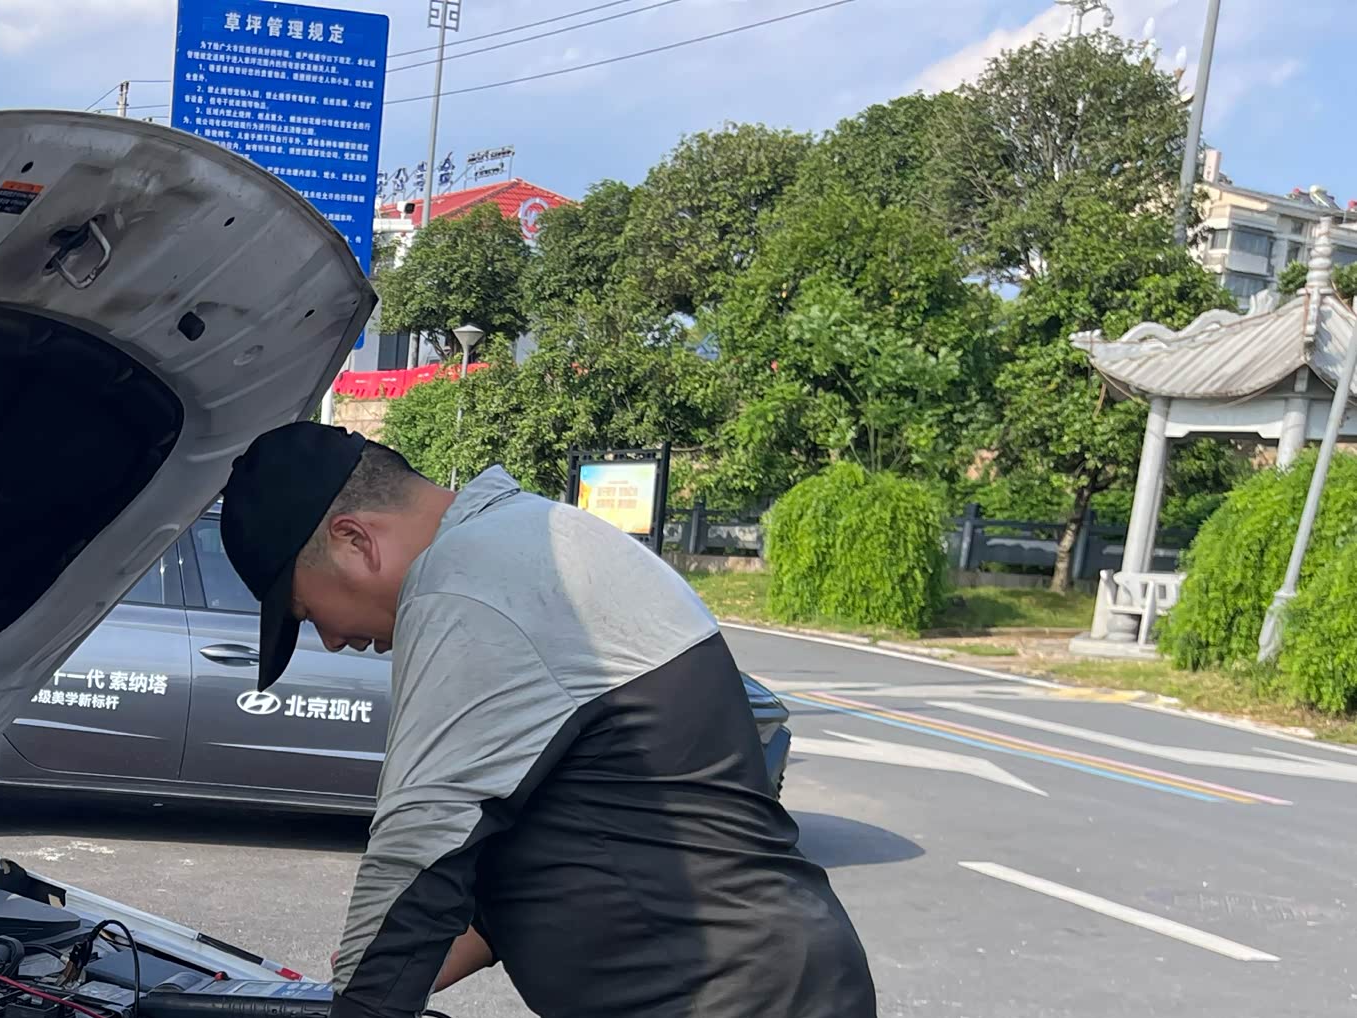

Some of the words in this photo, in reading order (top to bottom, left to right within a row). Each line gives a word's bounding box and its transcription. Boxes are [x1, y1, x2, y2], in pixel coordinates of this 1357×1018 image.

[224, 12, 345, 44] 草坪管理规定
[109, 671, 169, 696] 索纳塔
[31, 688, 120, 710] 级美学新标杆
[284, 694, 373, 723] 北京现代
